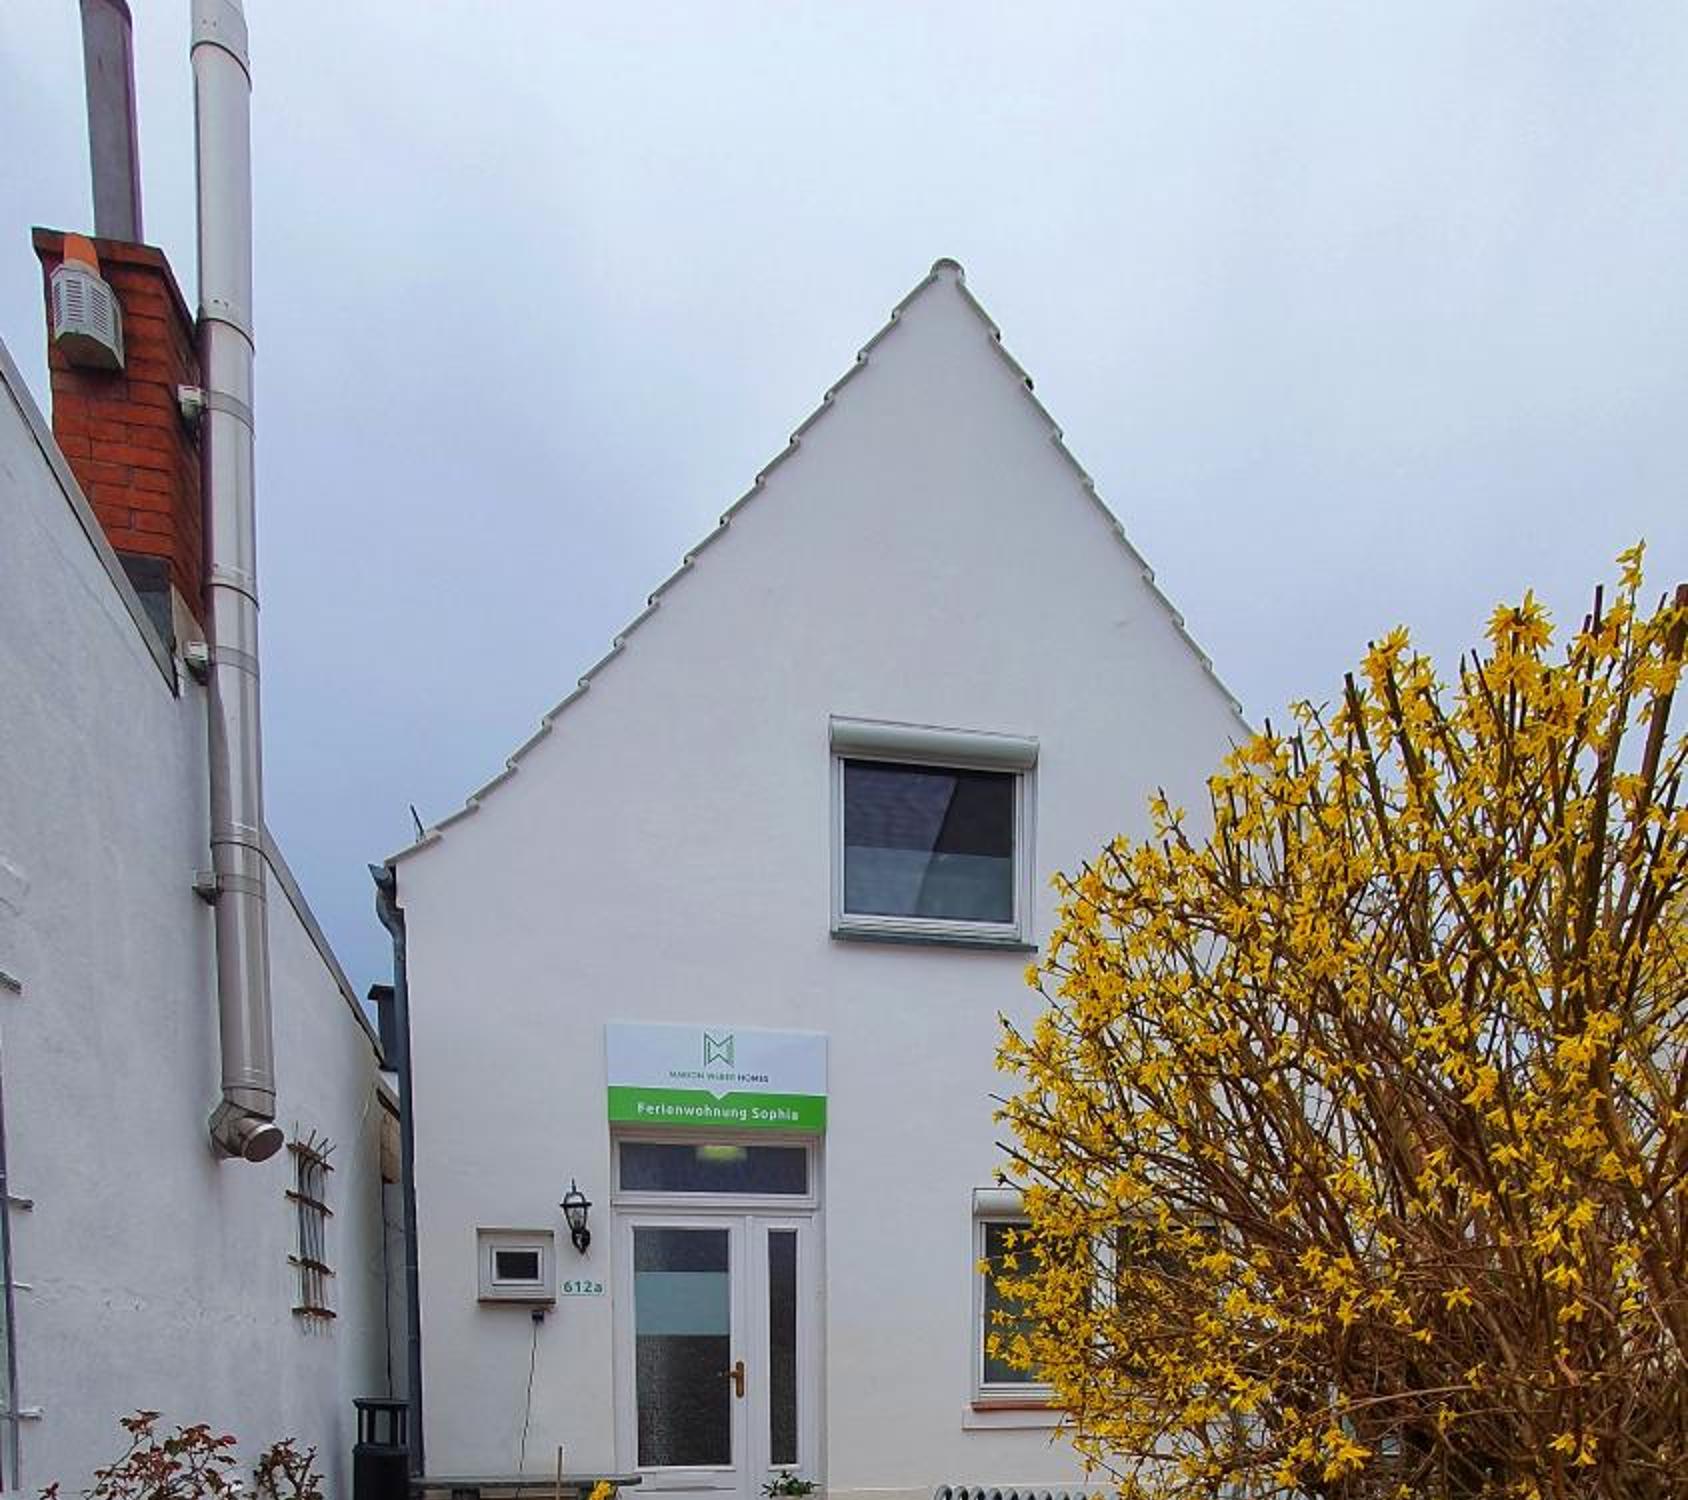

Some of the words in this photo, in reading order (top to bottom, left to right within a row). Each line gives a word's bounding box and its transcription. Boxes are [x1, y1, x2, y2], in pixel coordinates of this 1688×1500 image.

[738, 1073, 769, 1083] HOMES
[637, 1103, 747, 1120] Ferienwohnung
[751, 1107, 798, 1121] Sophia
[563, 1280, 603, 1293] 612a
